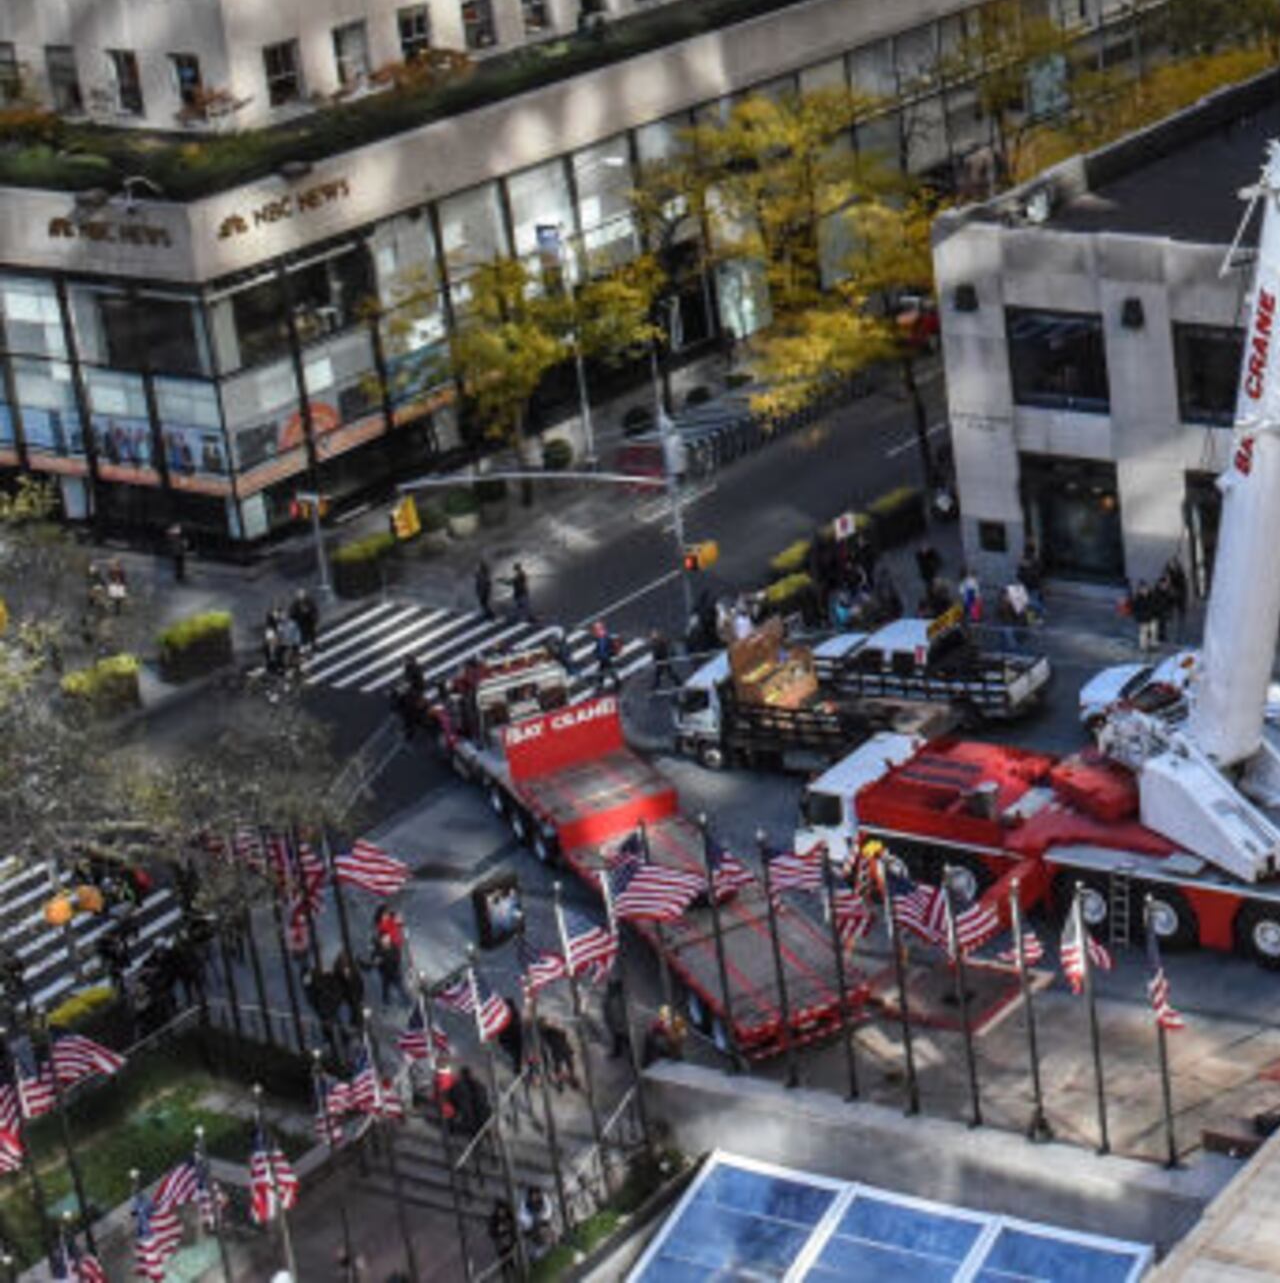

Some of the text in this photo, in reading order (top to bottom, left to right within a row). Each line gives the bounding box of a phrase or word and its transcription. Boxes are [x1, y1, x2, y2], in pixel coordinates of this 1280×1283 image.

[253, 178, 349, 228] NBC NEWS
[1233, 286, 1276, 478] BA CRANE
[504, 696, 618, 748] BAY CRANE
